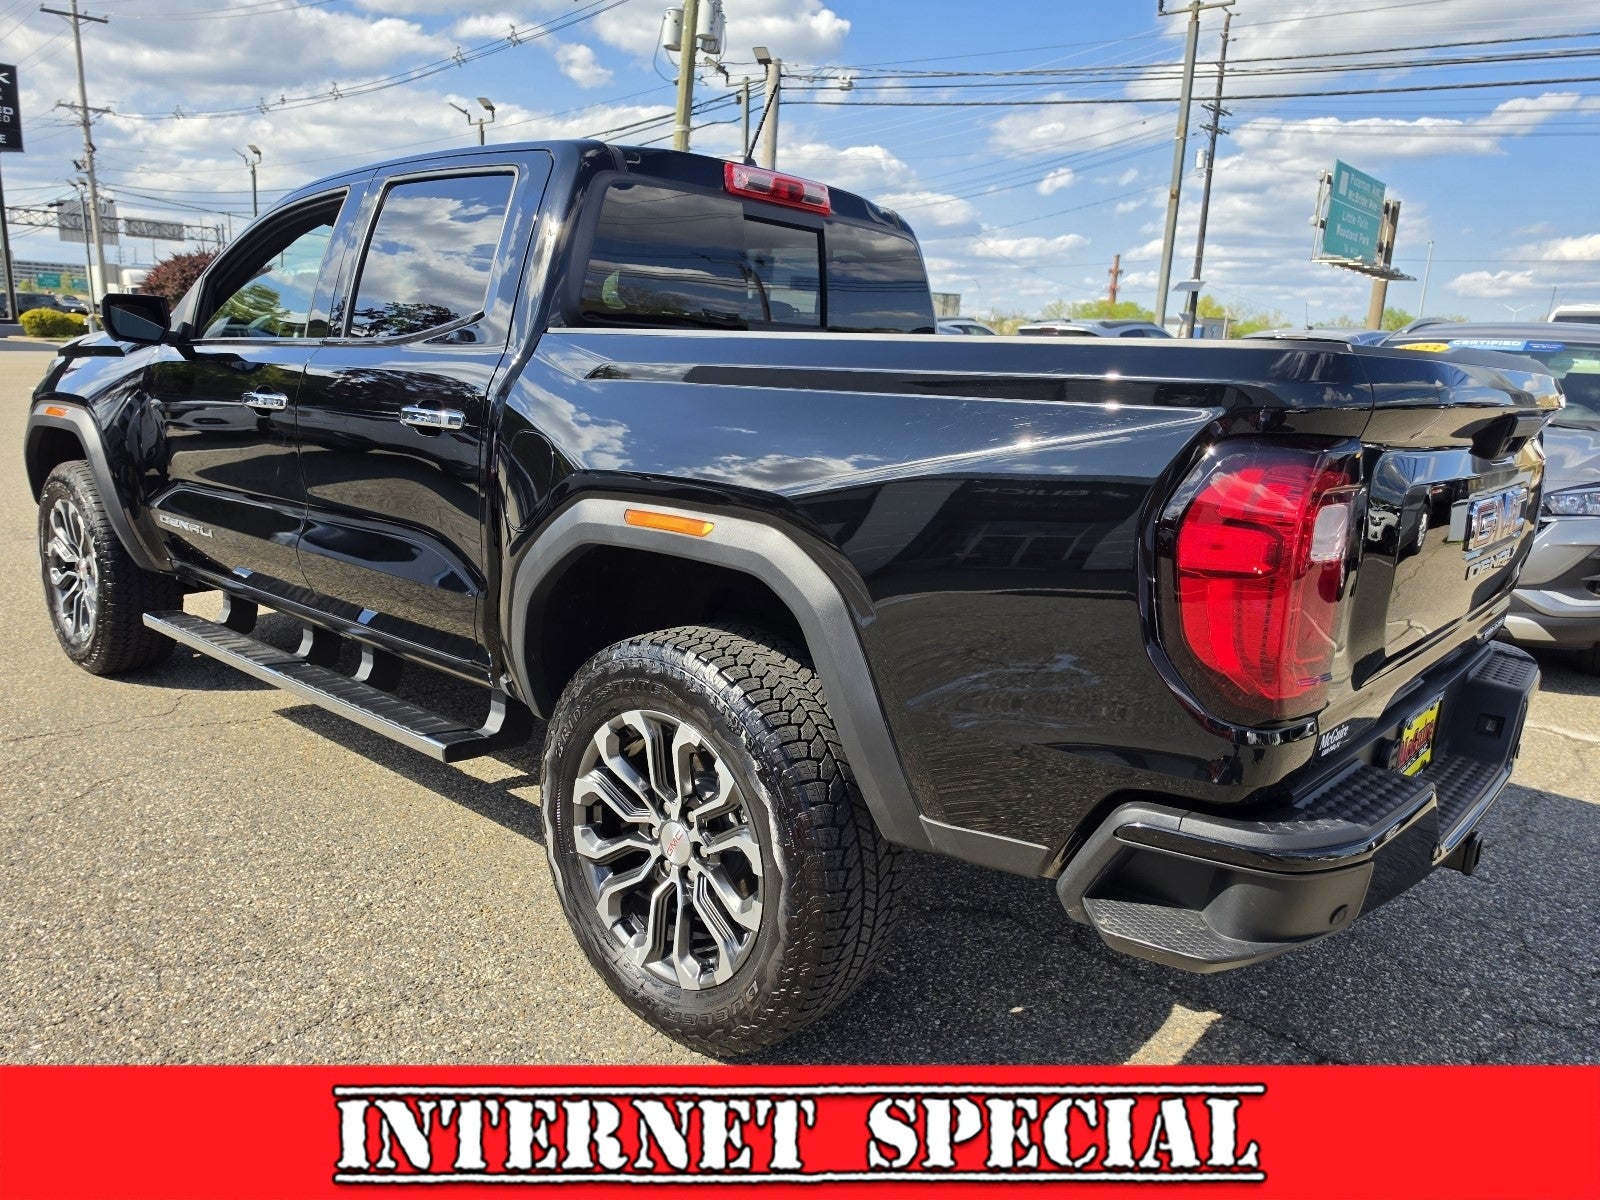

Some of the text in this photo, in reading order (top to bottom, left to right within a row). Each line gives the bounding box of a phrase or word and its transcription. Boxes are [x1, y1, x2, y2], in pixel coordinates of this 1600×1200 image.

[1452, 339, 1522, 347] CERTIFIED
[159, 514, 214, 539] DENALI
[1469, 485, 1528, 550] GMC
[555, 678, 665, 758] BRIDGESTONE
[666, 829, 683, 857] GMC
[663, 976, 760, 1026] DUELER
